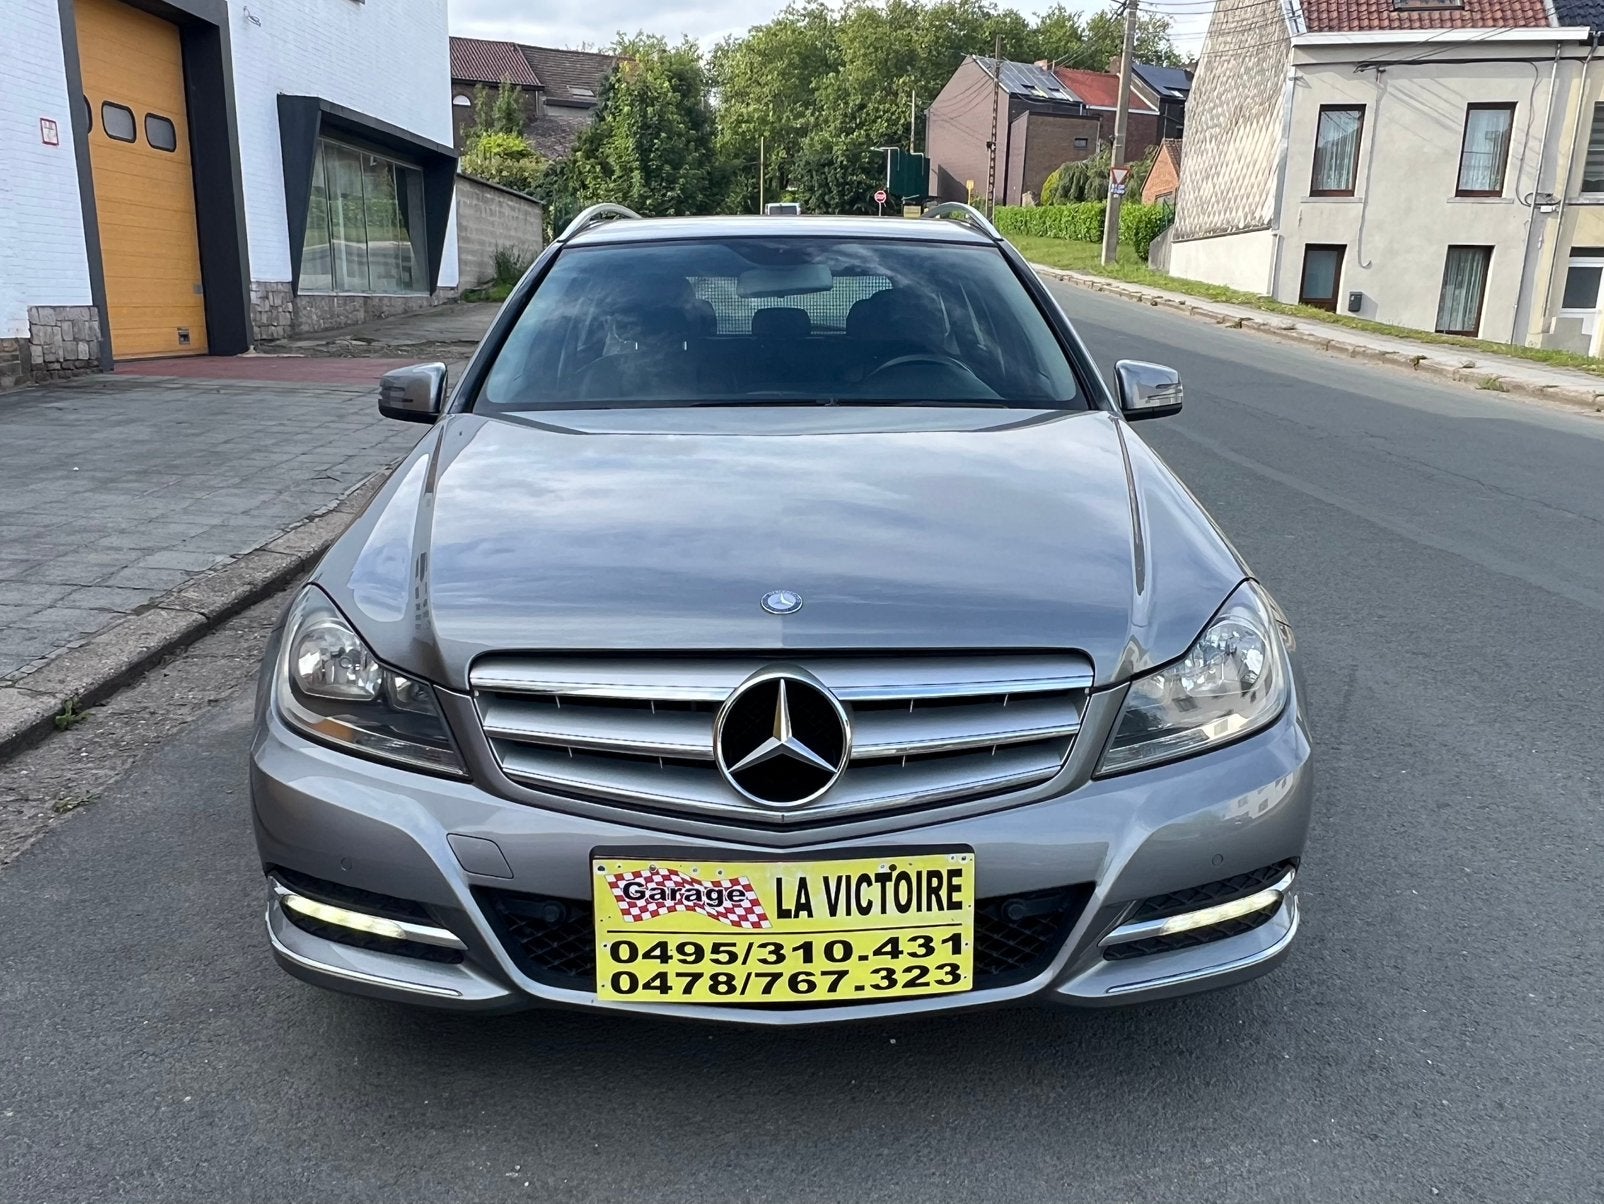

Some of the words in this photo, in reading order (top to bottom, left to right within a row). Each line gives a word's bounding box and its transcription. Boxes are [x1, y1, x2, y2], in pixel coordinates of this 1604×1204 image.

[622, 881, 747, 908] Garage
[776, 877, 814, 920] LA
[822, 868, 963, 918] VICTOIRE
[609, 932, 962, 966] 0495/310.431
[610, 963, 962, 996] 0478/767.323
